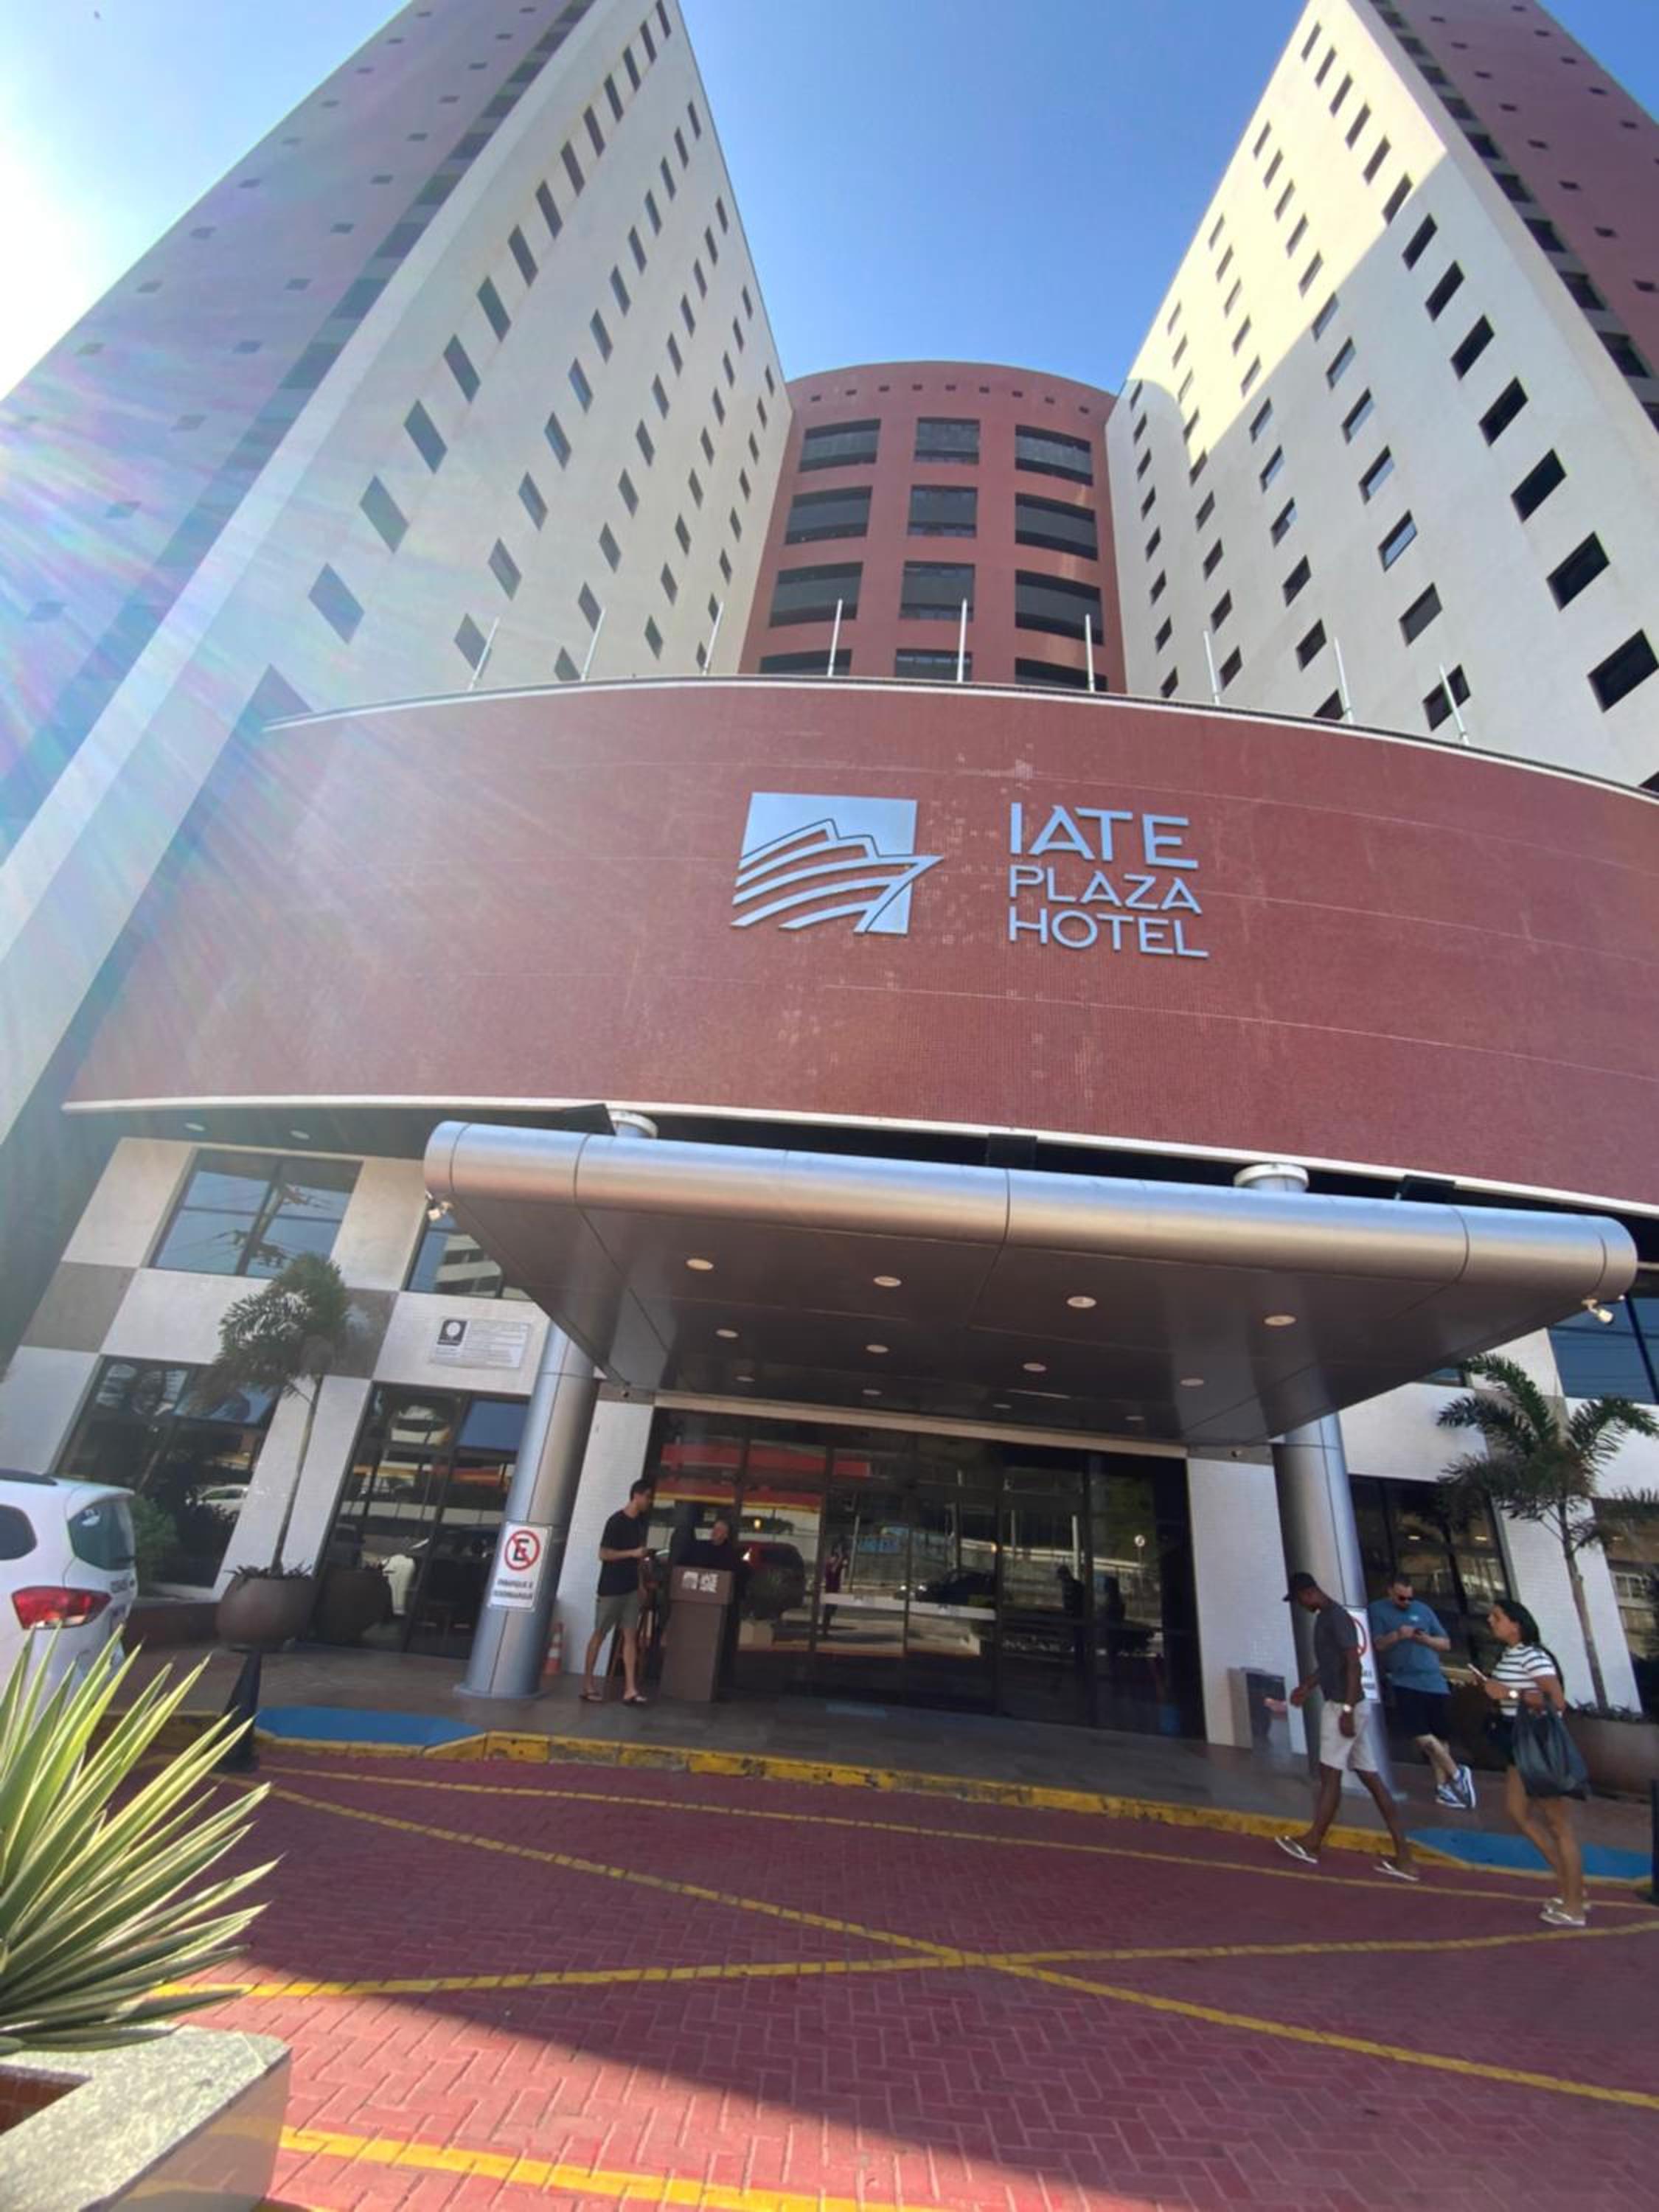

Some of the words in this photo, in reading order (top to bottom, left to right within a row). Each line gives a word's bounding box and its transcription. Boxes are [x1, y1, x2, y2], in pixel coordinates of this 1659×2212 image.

[1010, 801, 1199, 869] IATE
[1009, 864, 1203, 915] PLAZA
[1009, 905, 1210, 958] HOTEL
